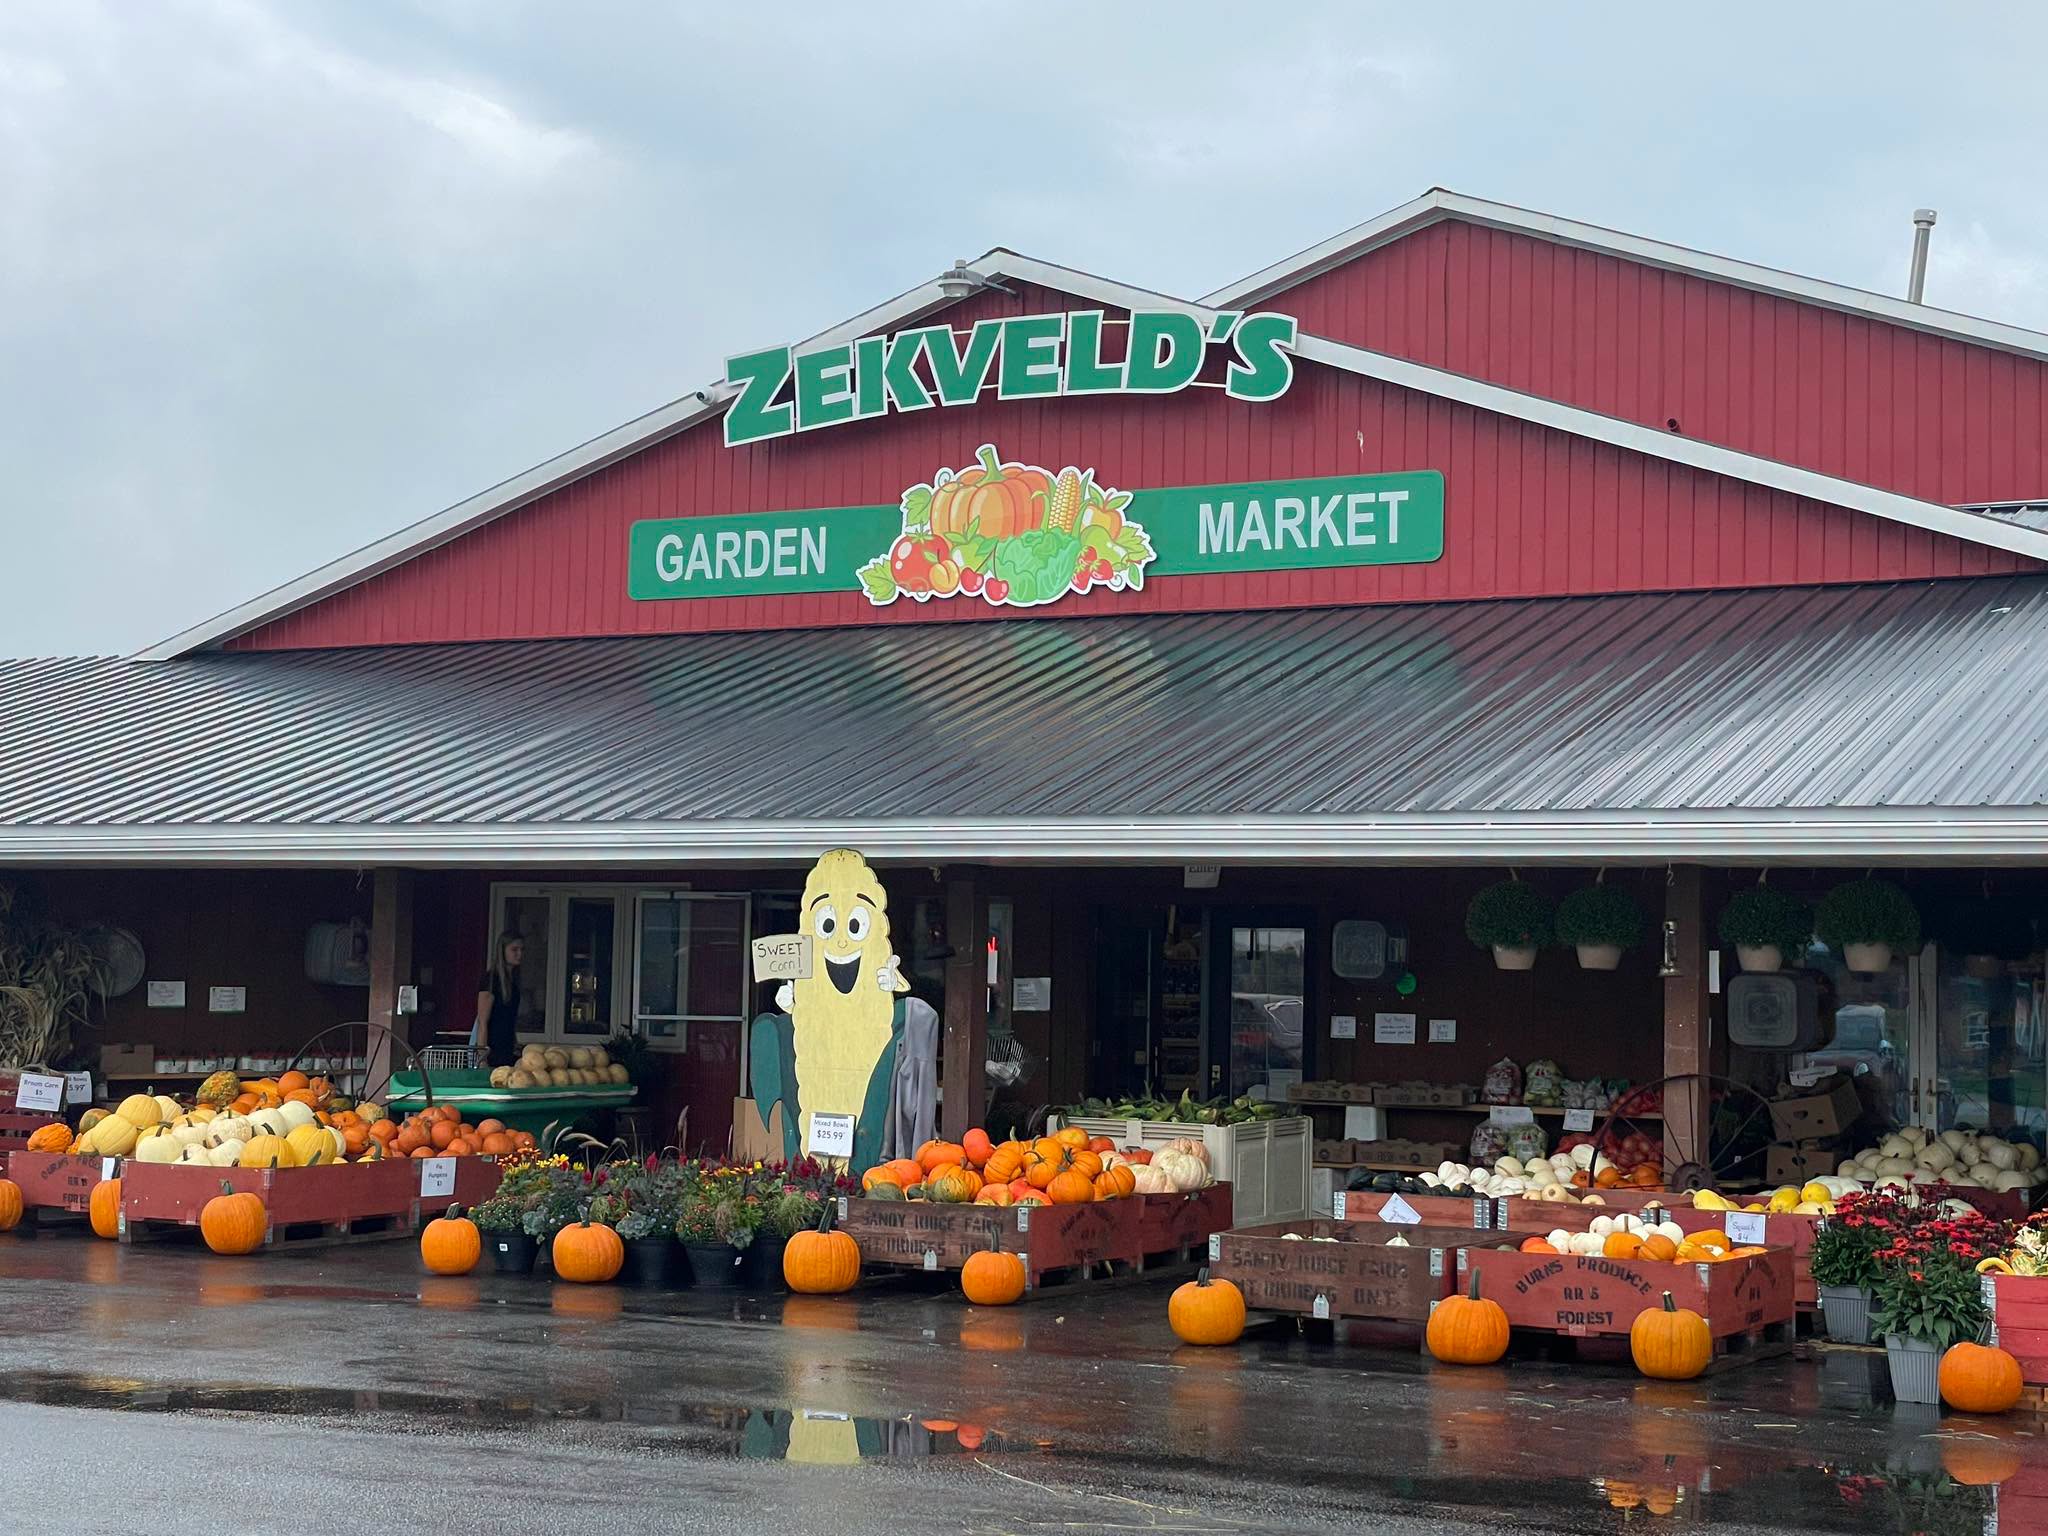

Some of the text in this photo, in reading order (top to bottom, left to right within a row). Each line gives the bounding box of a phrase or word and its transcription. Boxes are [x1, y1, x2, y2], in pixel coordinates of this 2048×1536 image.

[724, 310, 1298, 448] ZEKVELD'S
[656, 491, 1409, 581] GARDEN MARKET
[757, 942, 802, 958] SWEET
[1515, 1256, 1652, 1296] BURNS PRODUCE
[1556, 1310, 1614, 1327] FOREST
